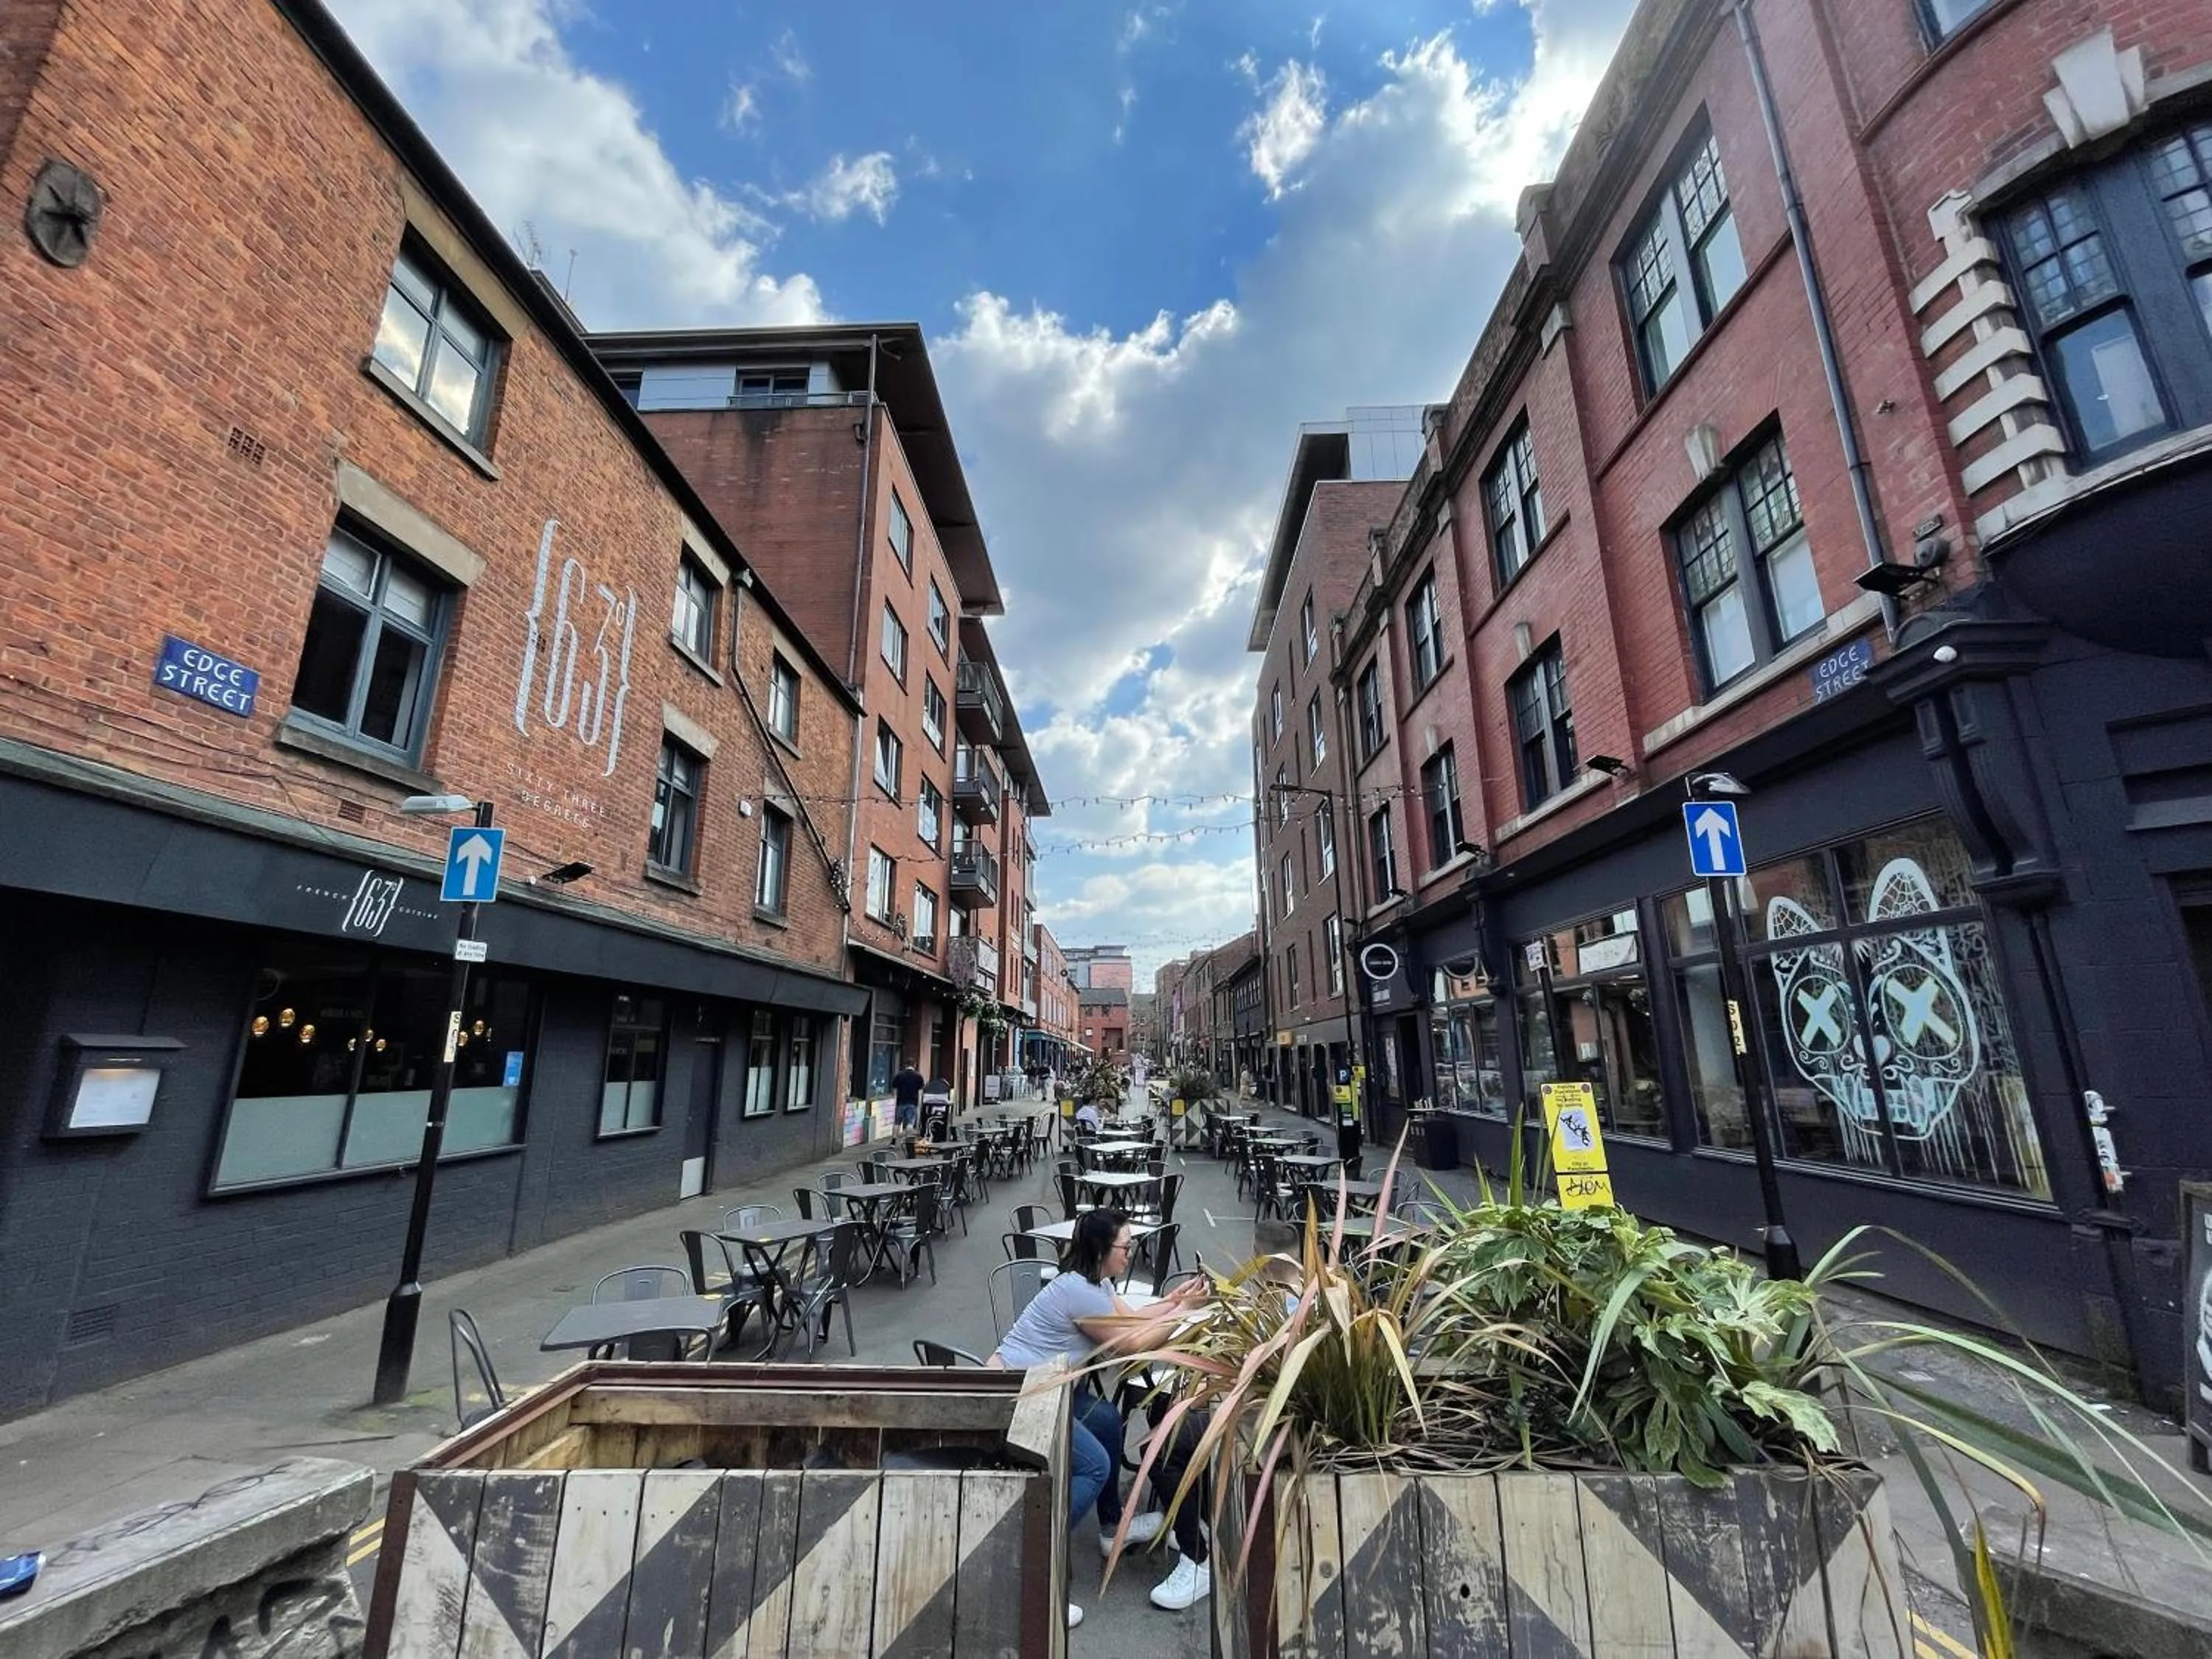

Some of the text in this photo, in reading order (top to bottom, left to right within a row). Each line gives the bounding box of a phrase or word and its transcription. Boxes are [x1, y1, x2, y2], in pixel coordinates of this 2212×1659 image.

[183, 650, 244, 686] EDGE
[1819, 645, 1859, 678] EDGE
[161, 664, 251, 710] STREET
[1816, 660, 1868, 703] STREET
[507, 762, 605, 818] SIXTY THREE
[1339, 1069, 1347, 1081] P
